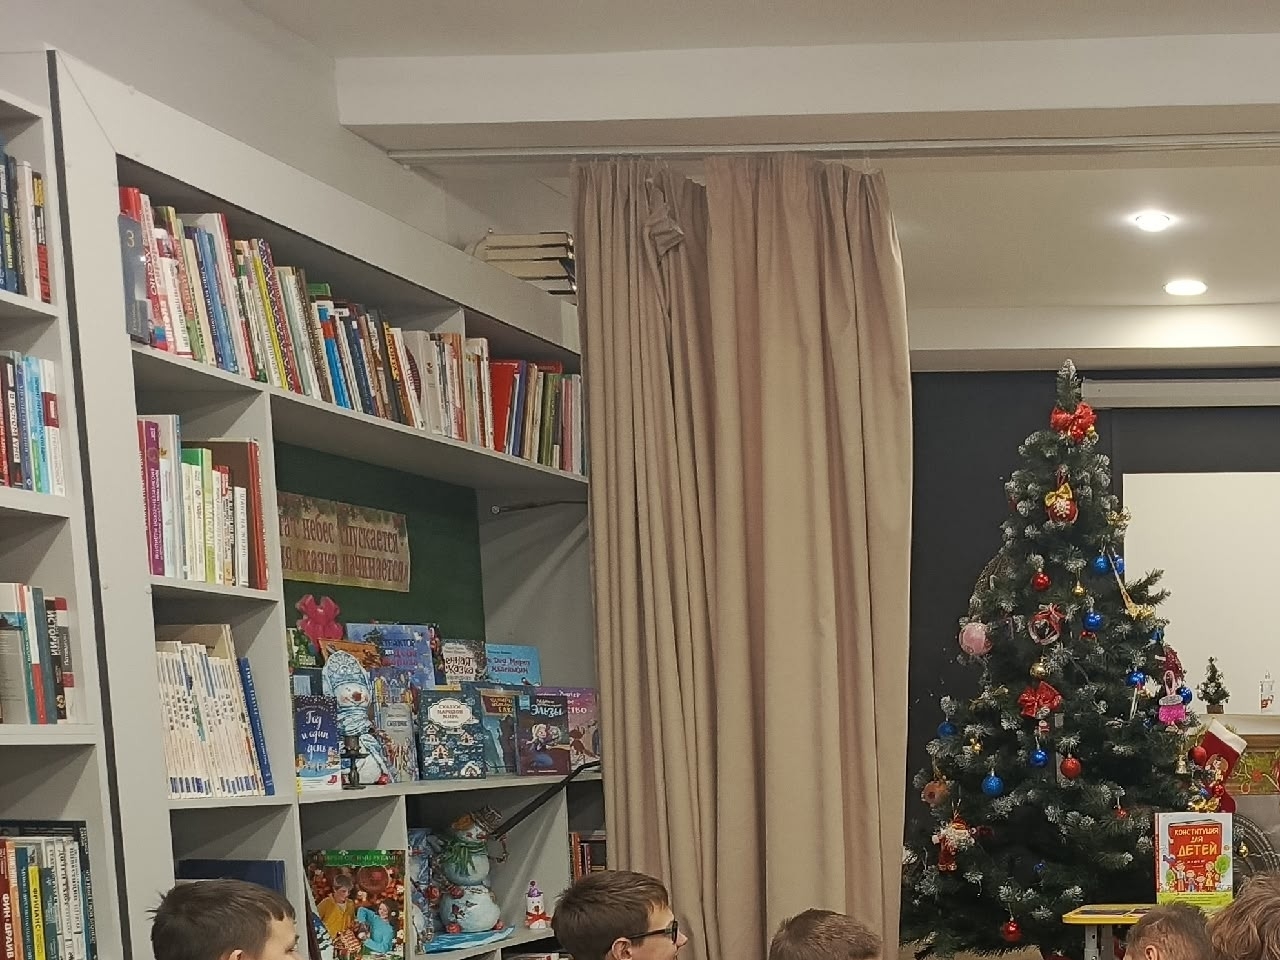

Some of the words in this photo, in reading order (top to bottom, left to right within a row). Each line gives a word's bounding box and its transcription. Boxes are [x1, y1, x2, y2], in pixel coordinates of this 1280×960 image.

[305, 710, 322, 730] Год
[308, 730, 329, 744] один
[1174, 827, 1219, 836] КОНСТИТУЦИЯ
[1177, 841, 1218, 857] ДЕТЕЙ
[32, 887, 42, 929] ФРИЛАНС
